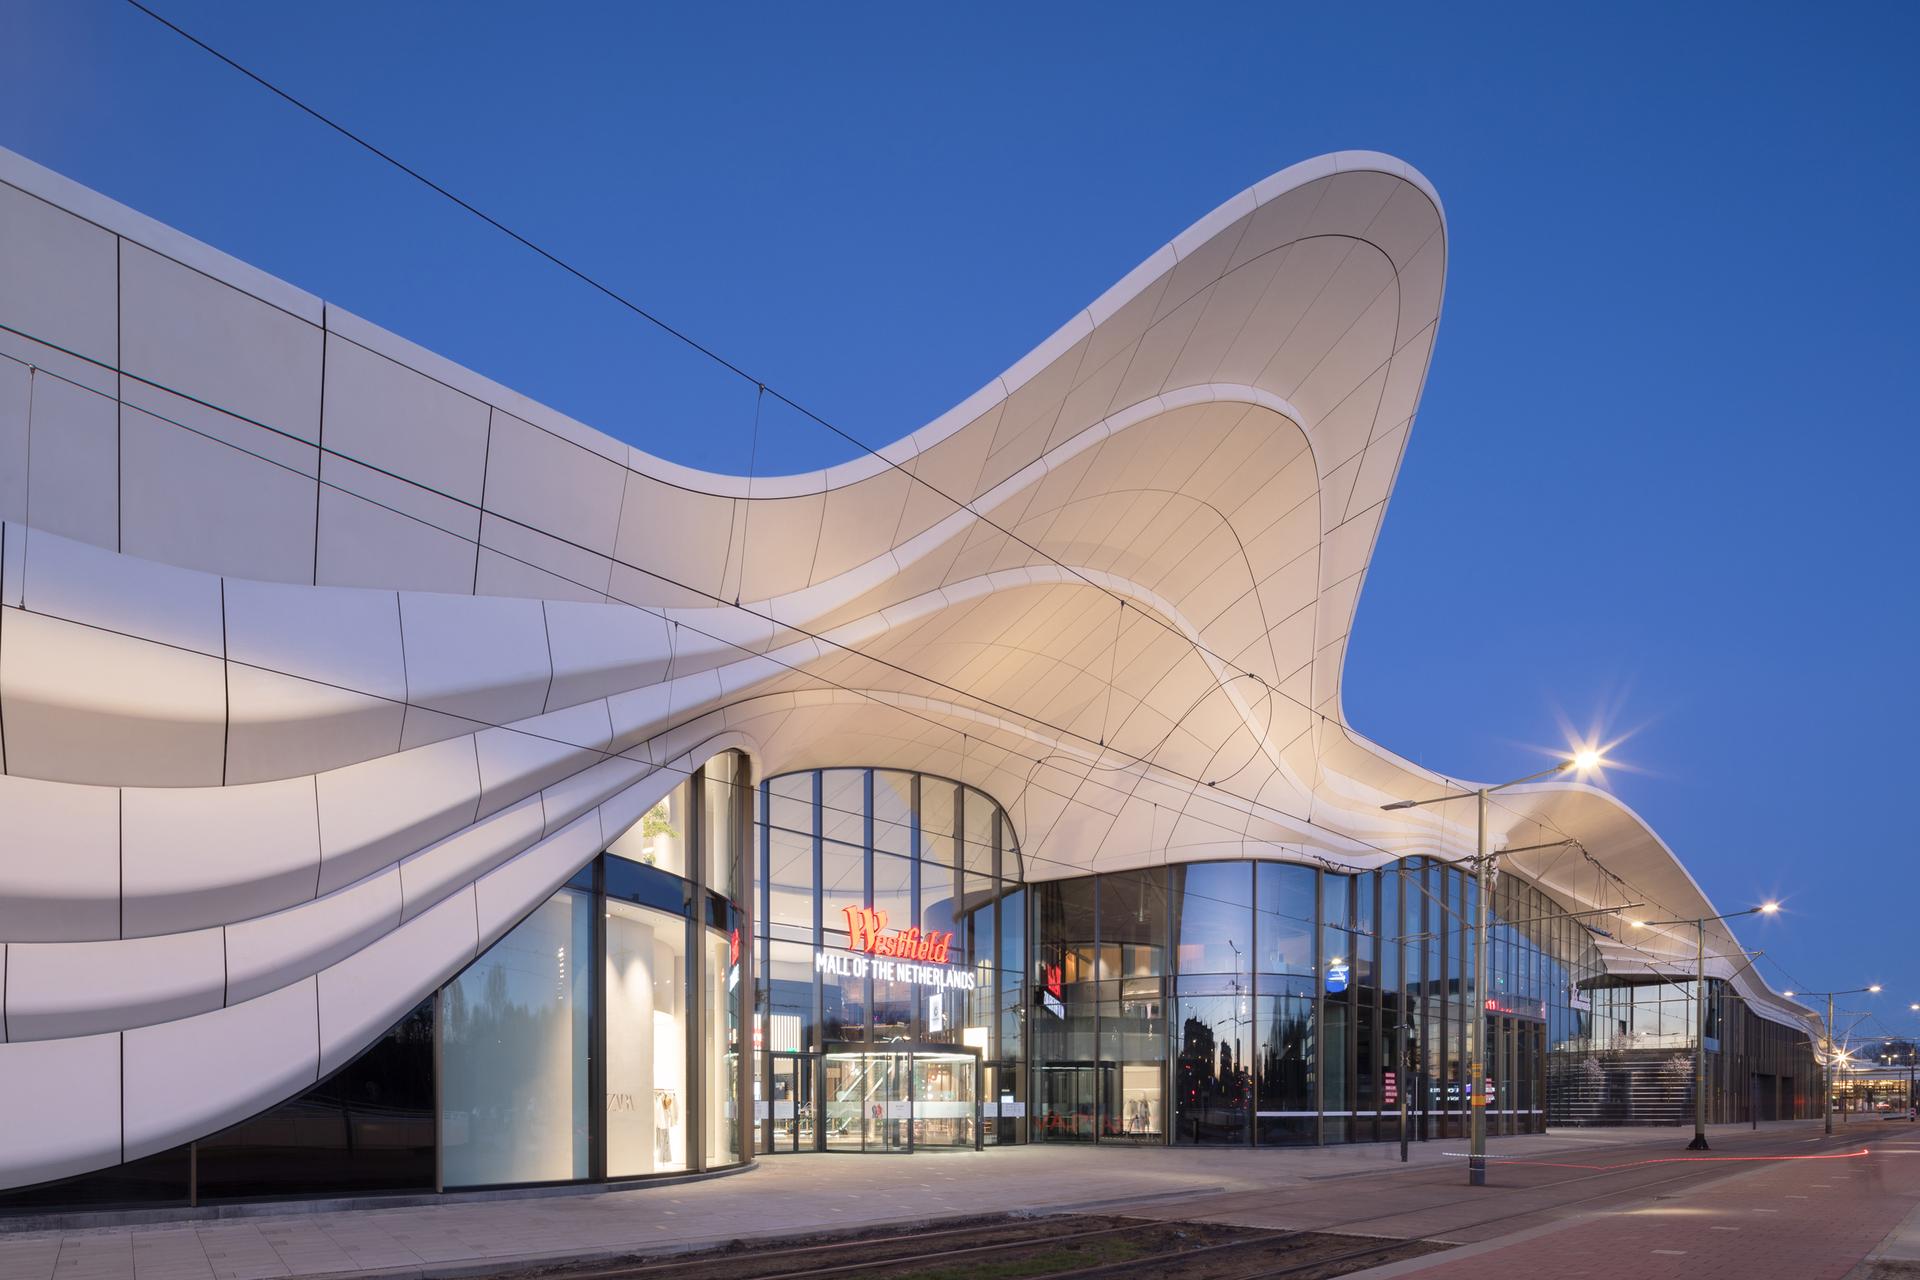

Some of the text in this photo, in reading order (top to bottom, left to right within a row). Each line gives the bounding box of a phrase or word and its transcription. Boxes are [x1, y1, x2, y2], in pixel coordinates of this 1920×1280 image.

[842, 905, 952, 963] Westfield
[815, 952, 975, 990] MALL OF THE NETHERLANDS
